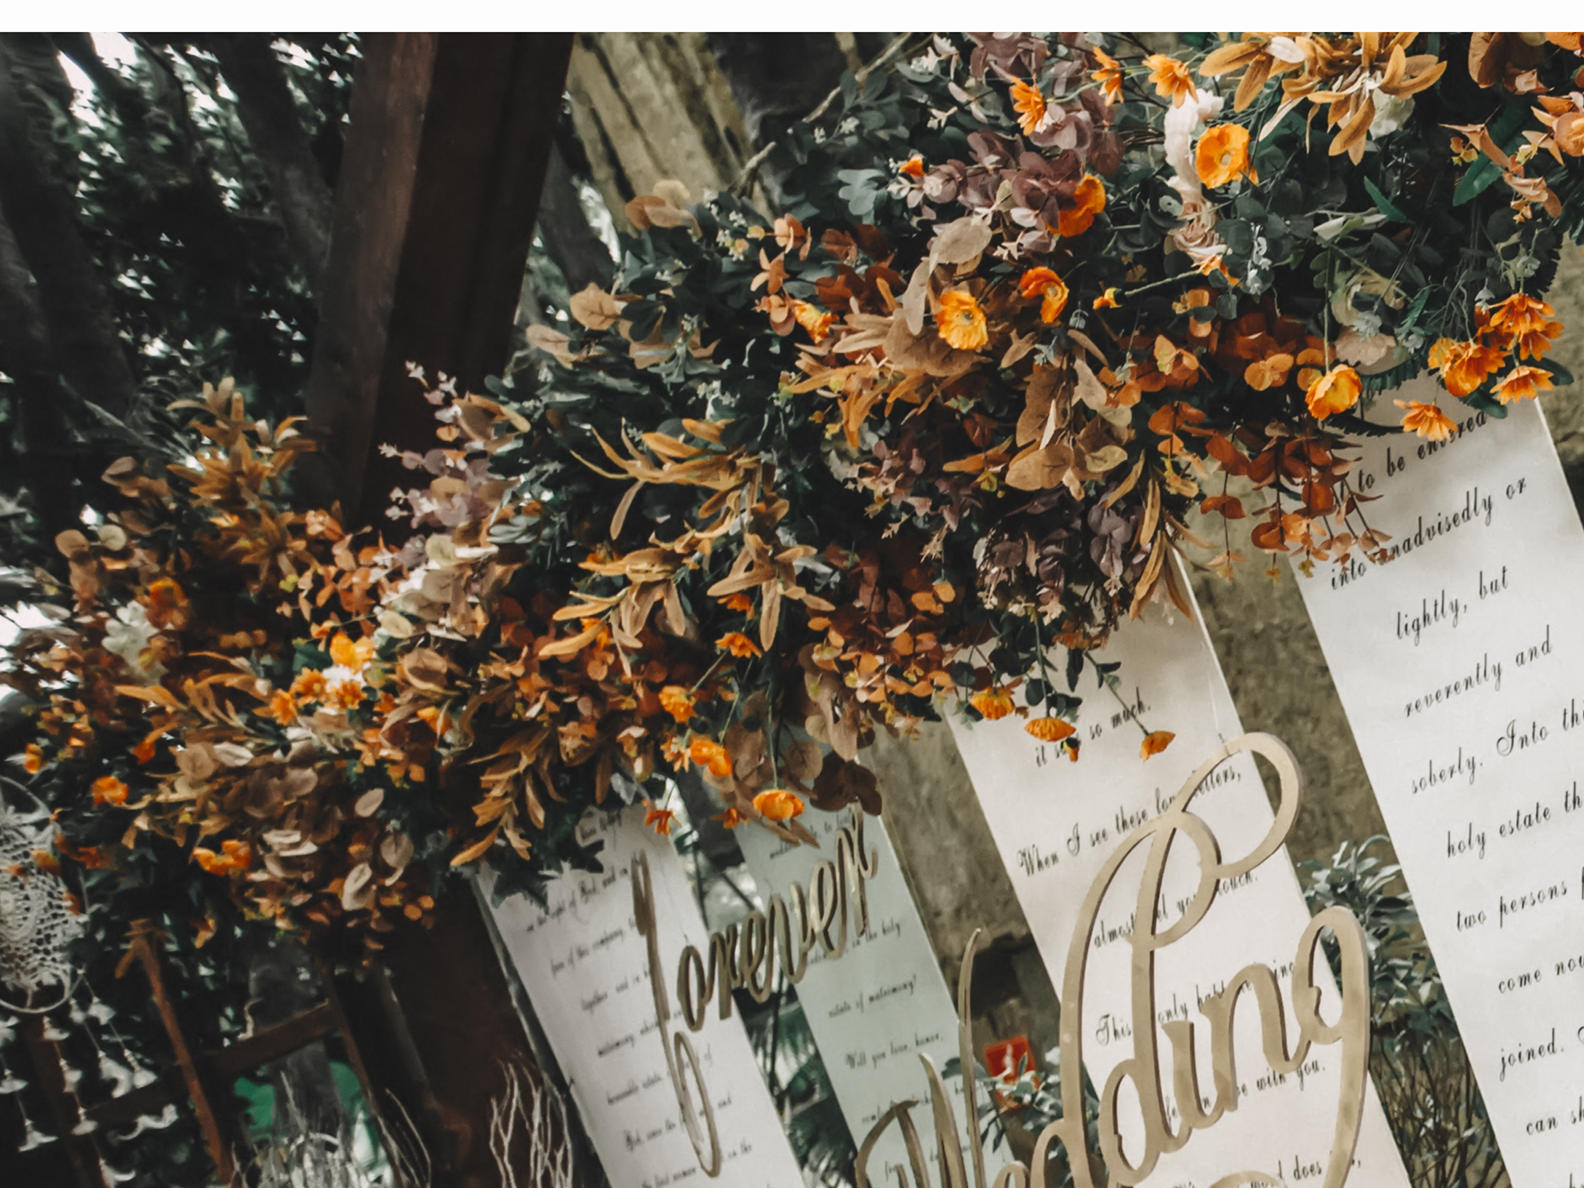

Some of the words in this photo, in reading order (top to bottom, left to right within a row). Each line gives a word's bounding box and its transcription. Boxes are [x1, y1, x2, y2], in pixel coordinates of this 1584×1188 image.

[1357, 469, 1376, 494] to
[1386, 446, 1406, 478] be
[1505, 477, 1527, 501] or
[1478, 565, 1508, 600] but
[1405, 652, 1503, 719] reverently
[1515, 623, 1553, 668] and
[1495, 718, 1549, 757] Into
[1115, 805, 1149, 836] these
[1446, 821, 1487, 860] holy
[1498, 801, 1552, 838] estate
[1456, 910, 1487, 932] two
[1499, 880, 1568, 929] persons
[1497, 968, 1541, 994] come
[1525, 1116, 1559, 1136] can
[1293, 1155, 1322, 1181] does
